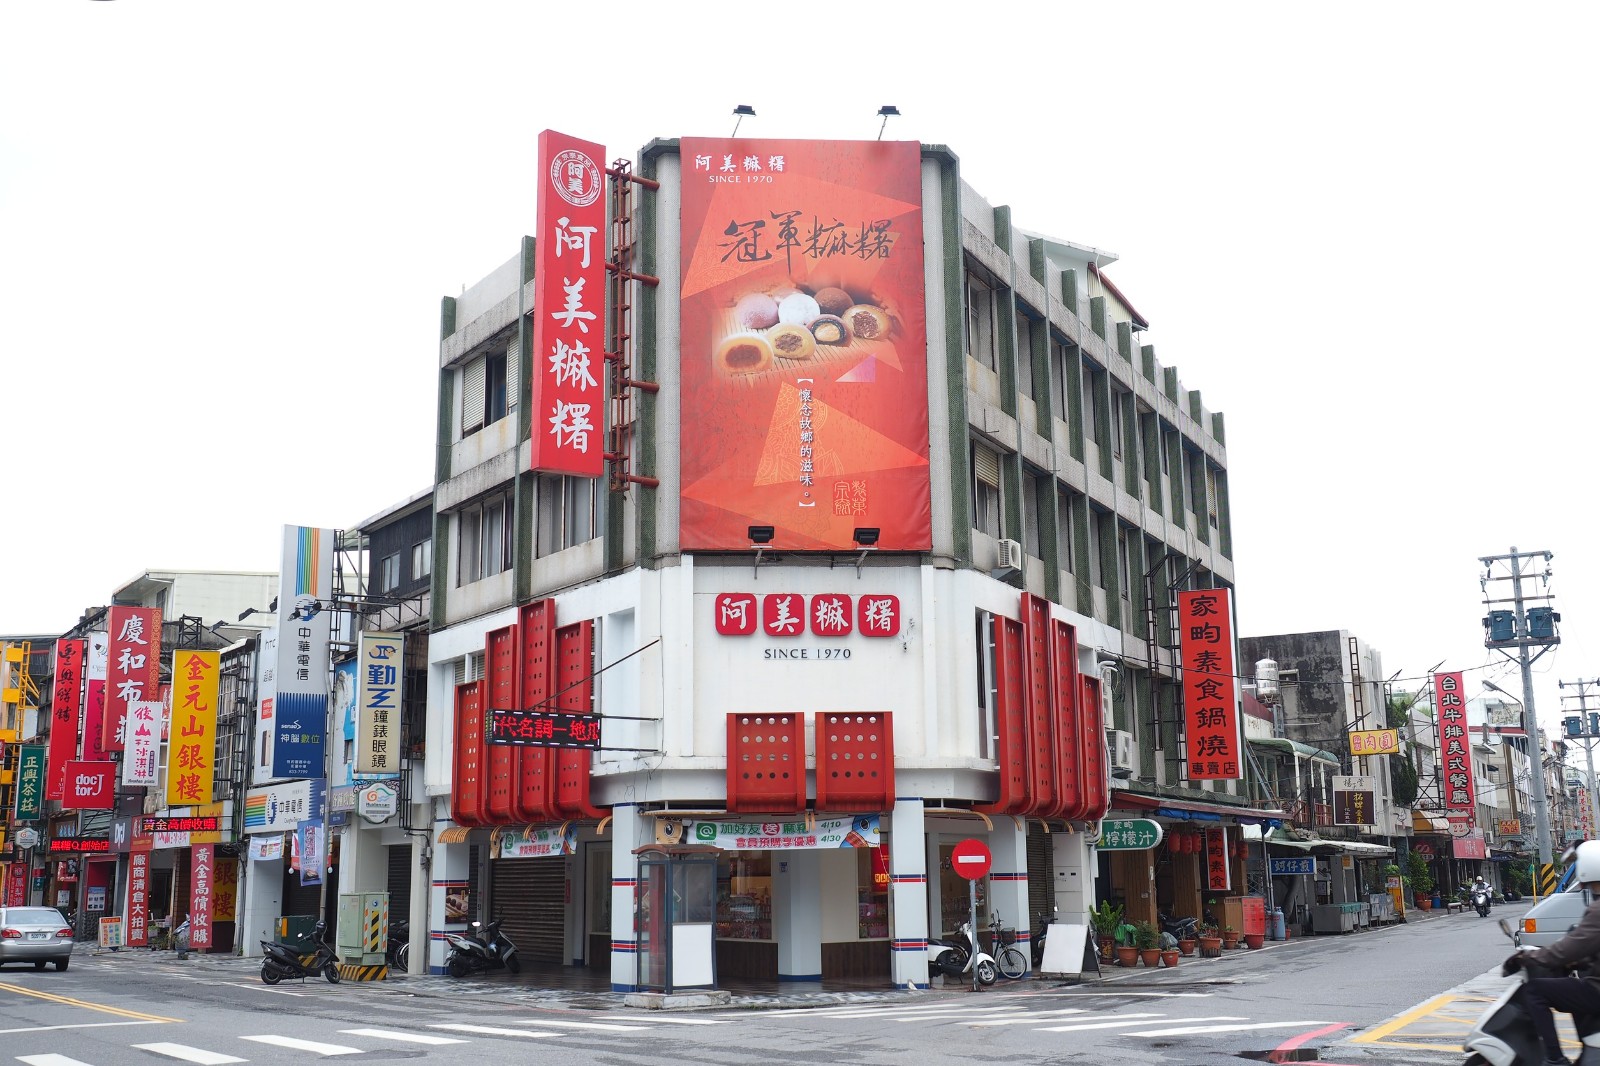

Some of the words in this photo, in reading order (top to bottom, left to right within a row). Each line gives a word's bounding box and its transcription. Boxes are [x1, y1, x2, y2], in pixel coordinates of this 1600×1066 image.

[709, 175, 741, 183] SINCE
[746, 175, 773, 183] 1970
[296, 626, 311, 681] 中華電信
[764, 648, 808, 659] SINCE
[816, 648, 852, 659] 1970
[176, 653, 212, 801] 金元山銀樓
[280, 733, 321, 744] 神腦數位
[371, 709, 389, 768] 鐘錶眼鏡
[1441, 675, 1471, 805] 台北牛排美式餐廳
[1191, 761, 1236, 775] 專賣店
[75, 773, 97, 785] doc
[143, 818, 216, 831] 黃金高價收購
[1105, 830, 1154, 847] 檸檬汁
[1274, 860, 1310, 872] 蚵仔煎
[130, 854, 146, 941] 廠商清倉大拍賣
[193, 848, 211, 944] 黃金高價收購
